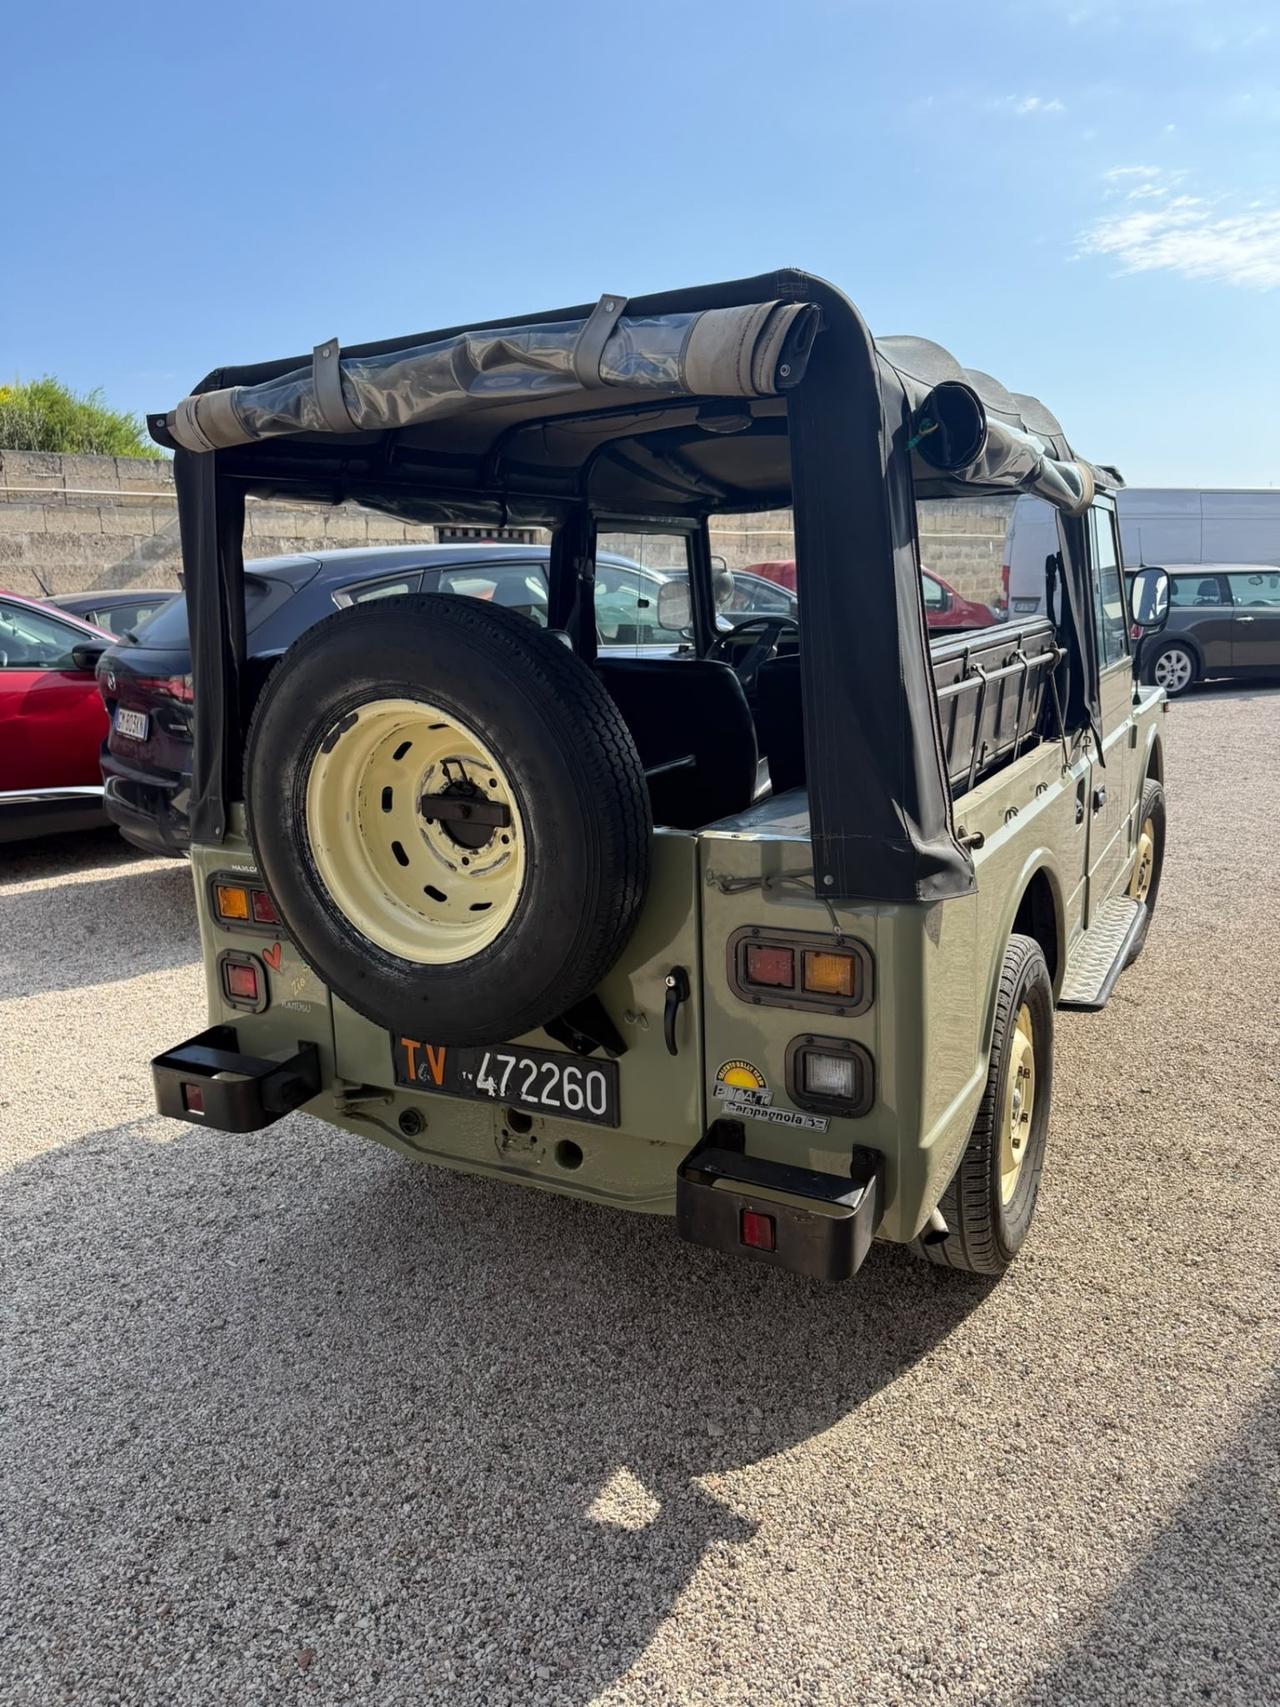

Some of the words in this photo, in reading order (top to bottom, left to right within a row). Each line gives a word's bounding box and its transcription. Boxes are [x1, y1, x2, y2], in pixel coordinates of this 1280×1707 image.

[401, 1037, 446, 1086] TV
[476, 1052, 607, 1115] 472260
[726, 1102, 803, 1125] Campagnola
